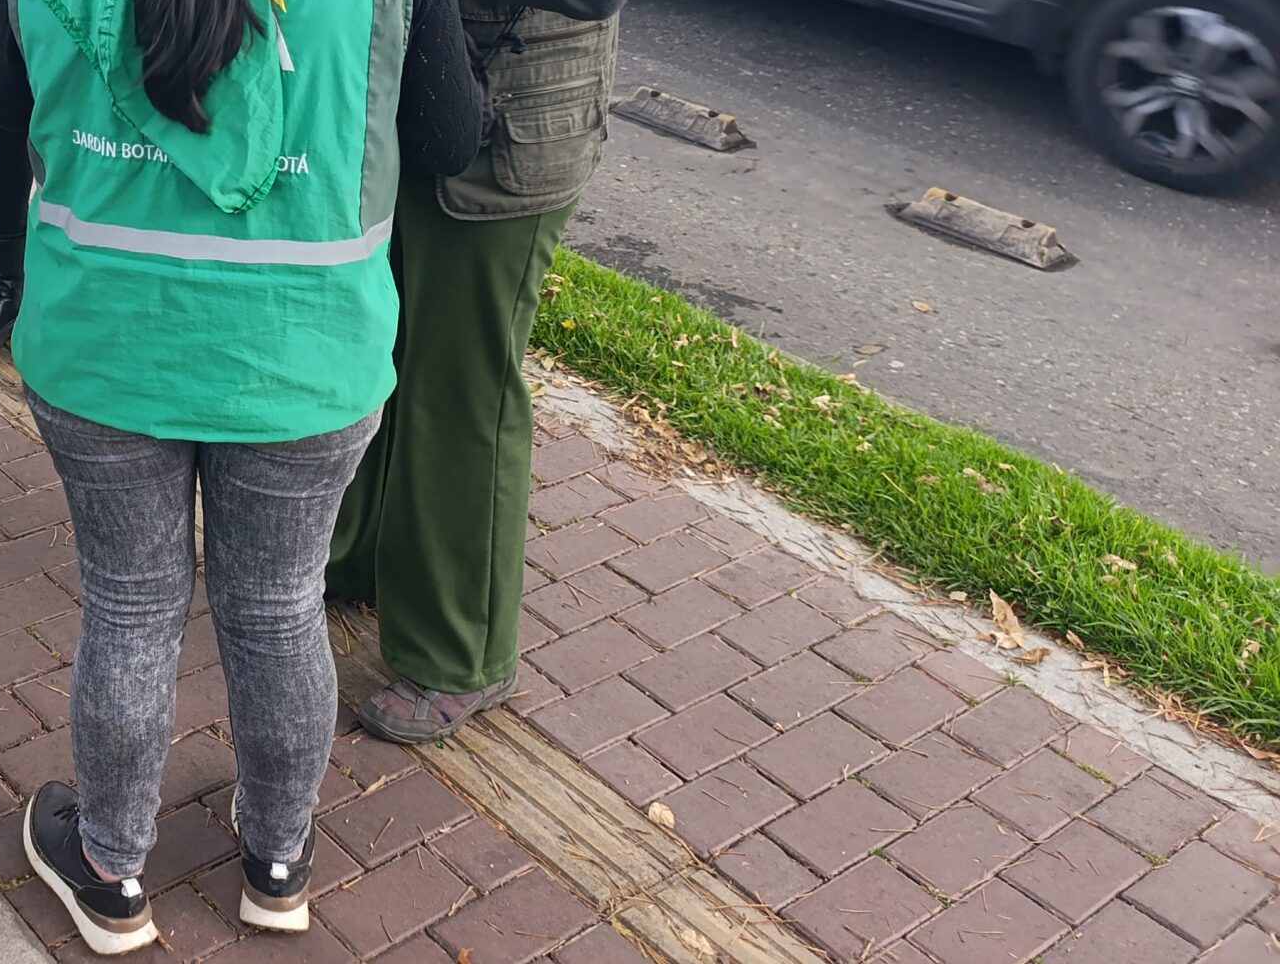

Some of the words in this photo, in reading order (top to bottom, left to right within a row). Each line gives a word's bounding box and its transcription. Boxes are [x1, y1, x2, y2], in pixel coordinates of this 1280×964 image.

[72, 129, 117, 158] JARDÍN
[121, 142, 168, 163] BOTA
[277, 153, 309, 174] OTÁ
